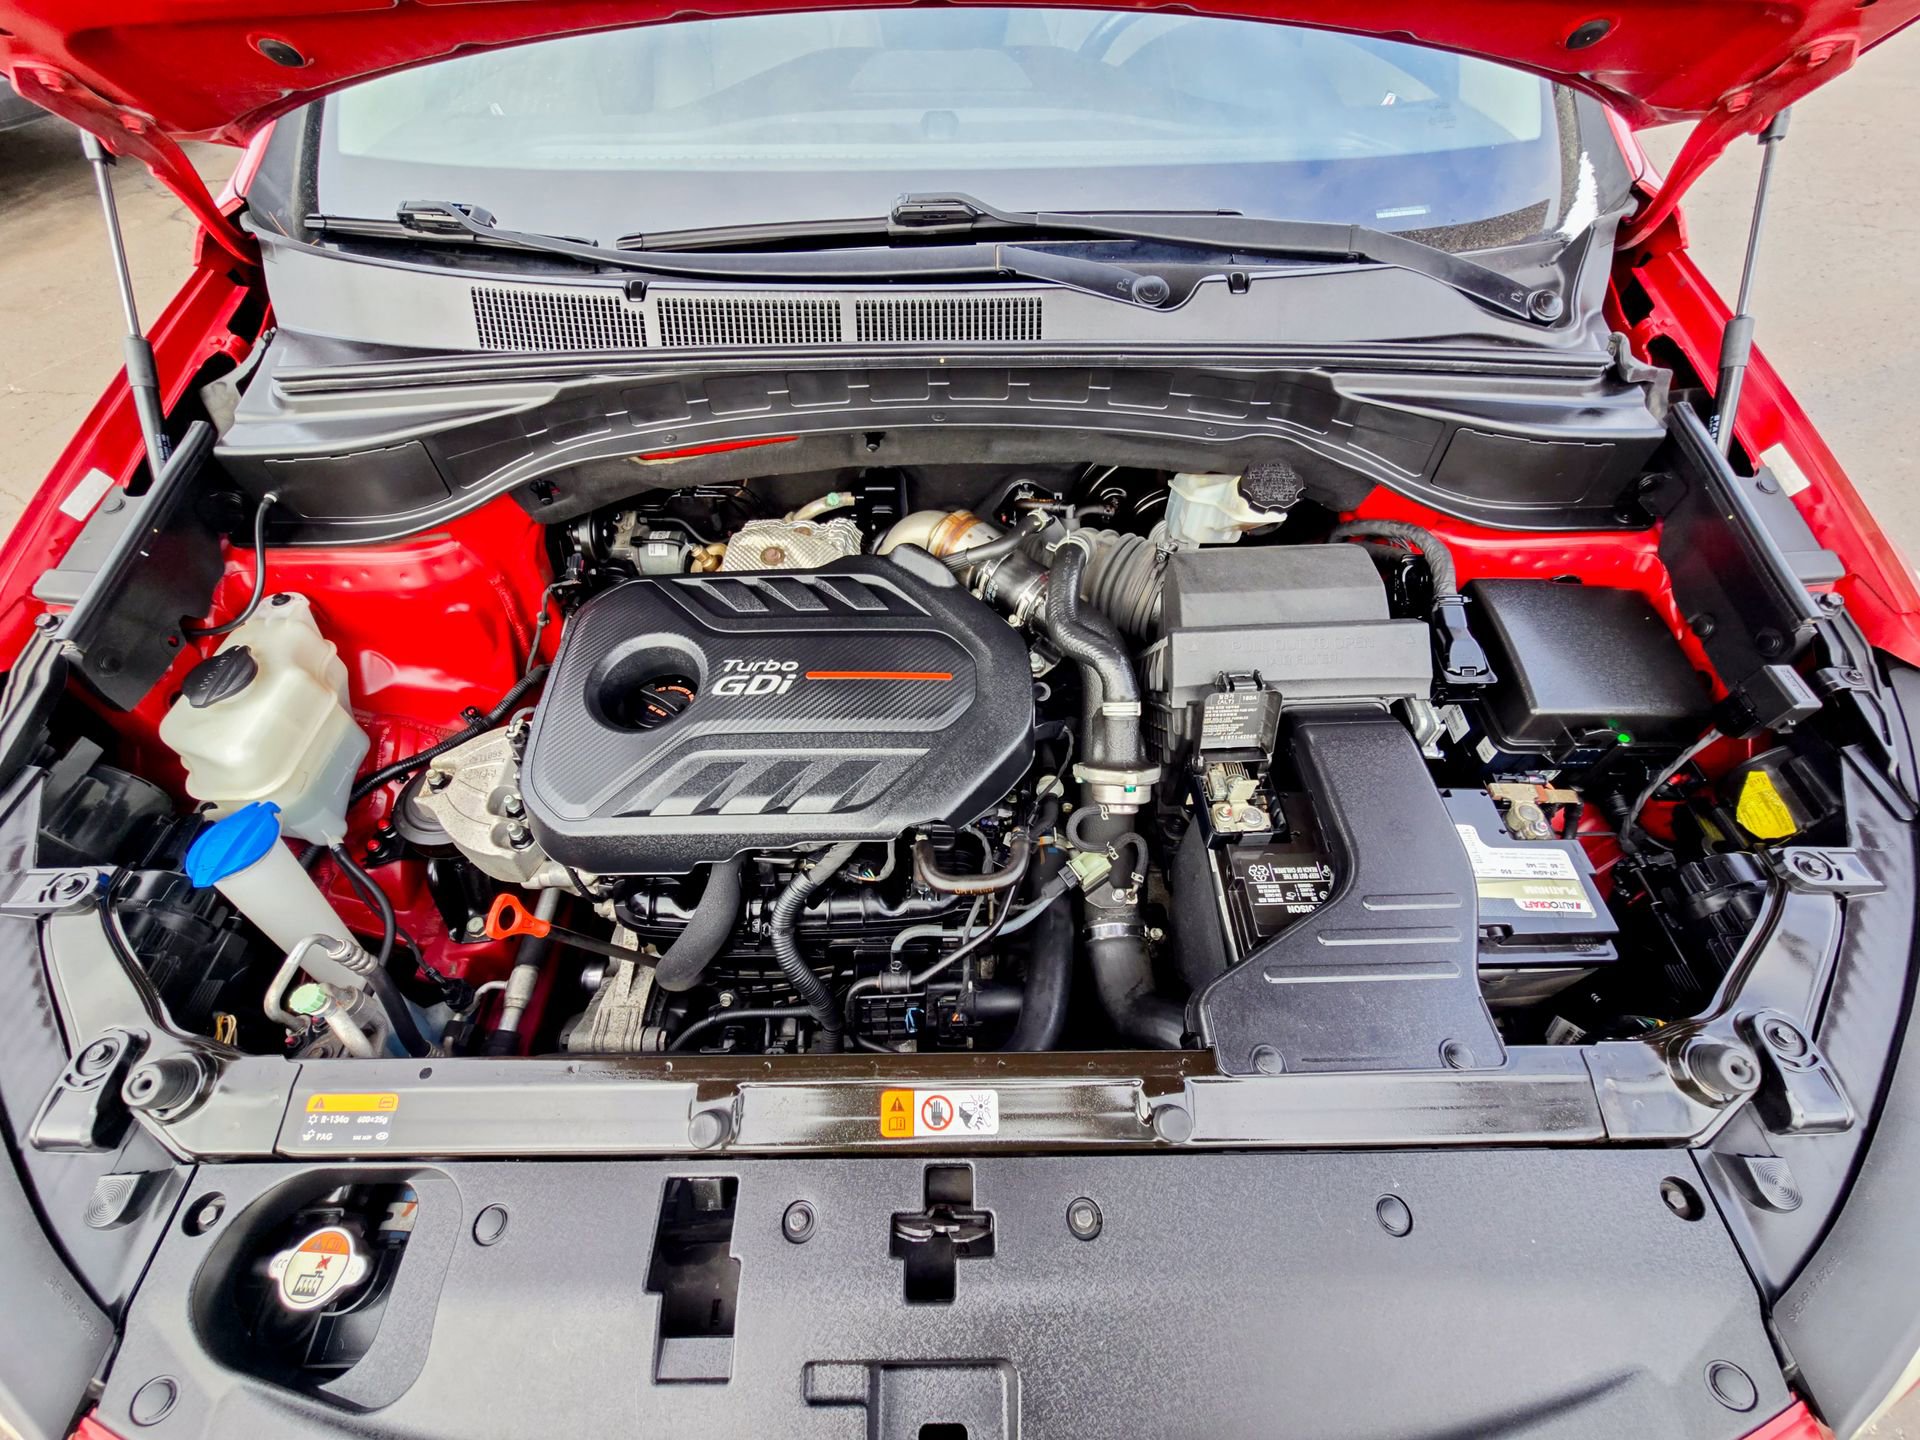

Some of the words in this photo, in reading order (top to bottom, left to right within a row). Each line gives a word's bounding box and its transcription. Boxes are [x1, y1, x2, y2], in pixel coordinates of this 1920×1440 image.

[722, 659, 799, 672] Turbo
[711, 674, 797, 696] GDi
[1523, 886, 1579, 896] PLATINUM
[1286, 904, 1320, 913] OISON
[1523, 901, 1576, 910] AUTOCRAFT
